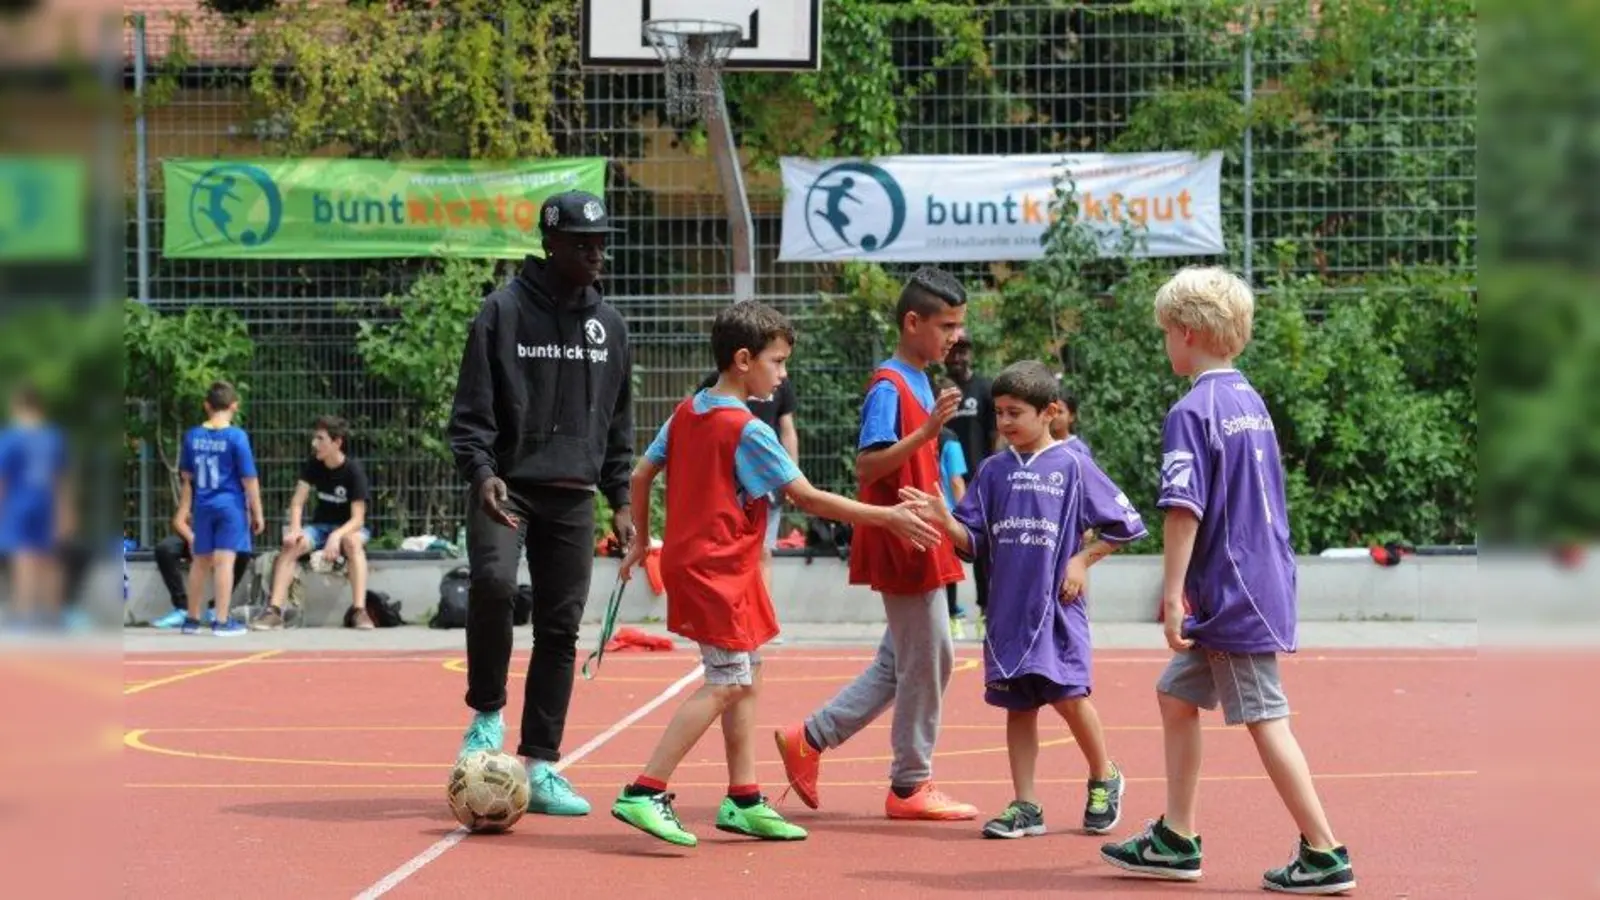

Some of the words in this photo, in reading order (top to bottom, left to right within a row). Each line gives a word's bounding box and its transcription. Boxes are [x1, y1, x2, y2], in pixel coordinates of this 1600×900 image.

[312, 192, 538, 232] buntkicktg
[926, 189, 1193, 227] buntkktgut
[517, 343, 608, 363] buntkickgut
[194, 454, 219, 489] 11
